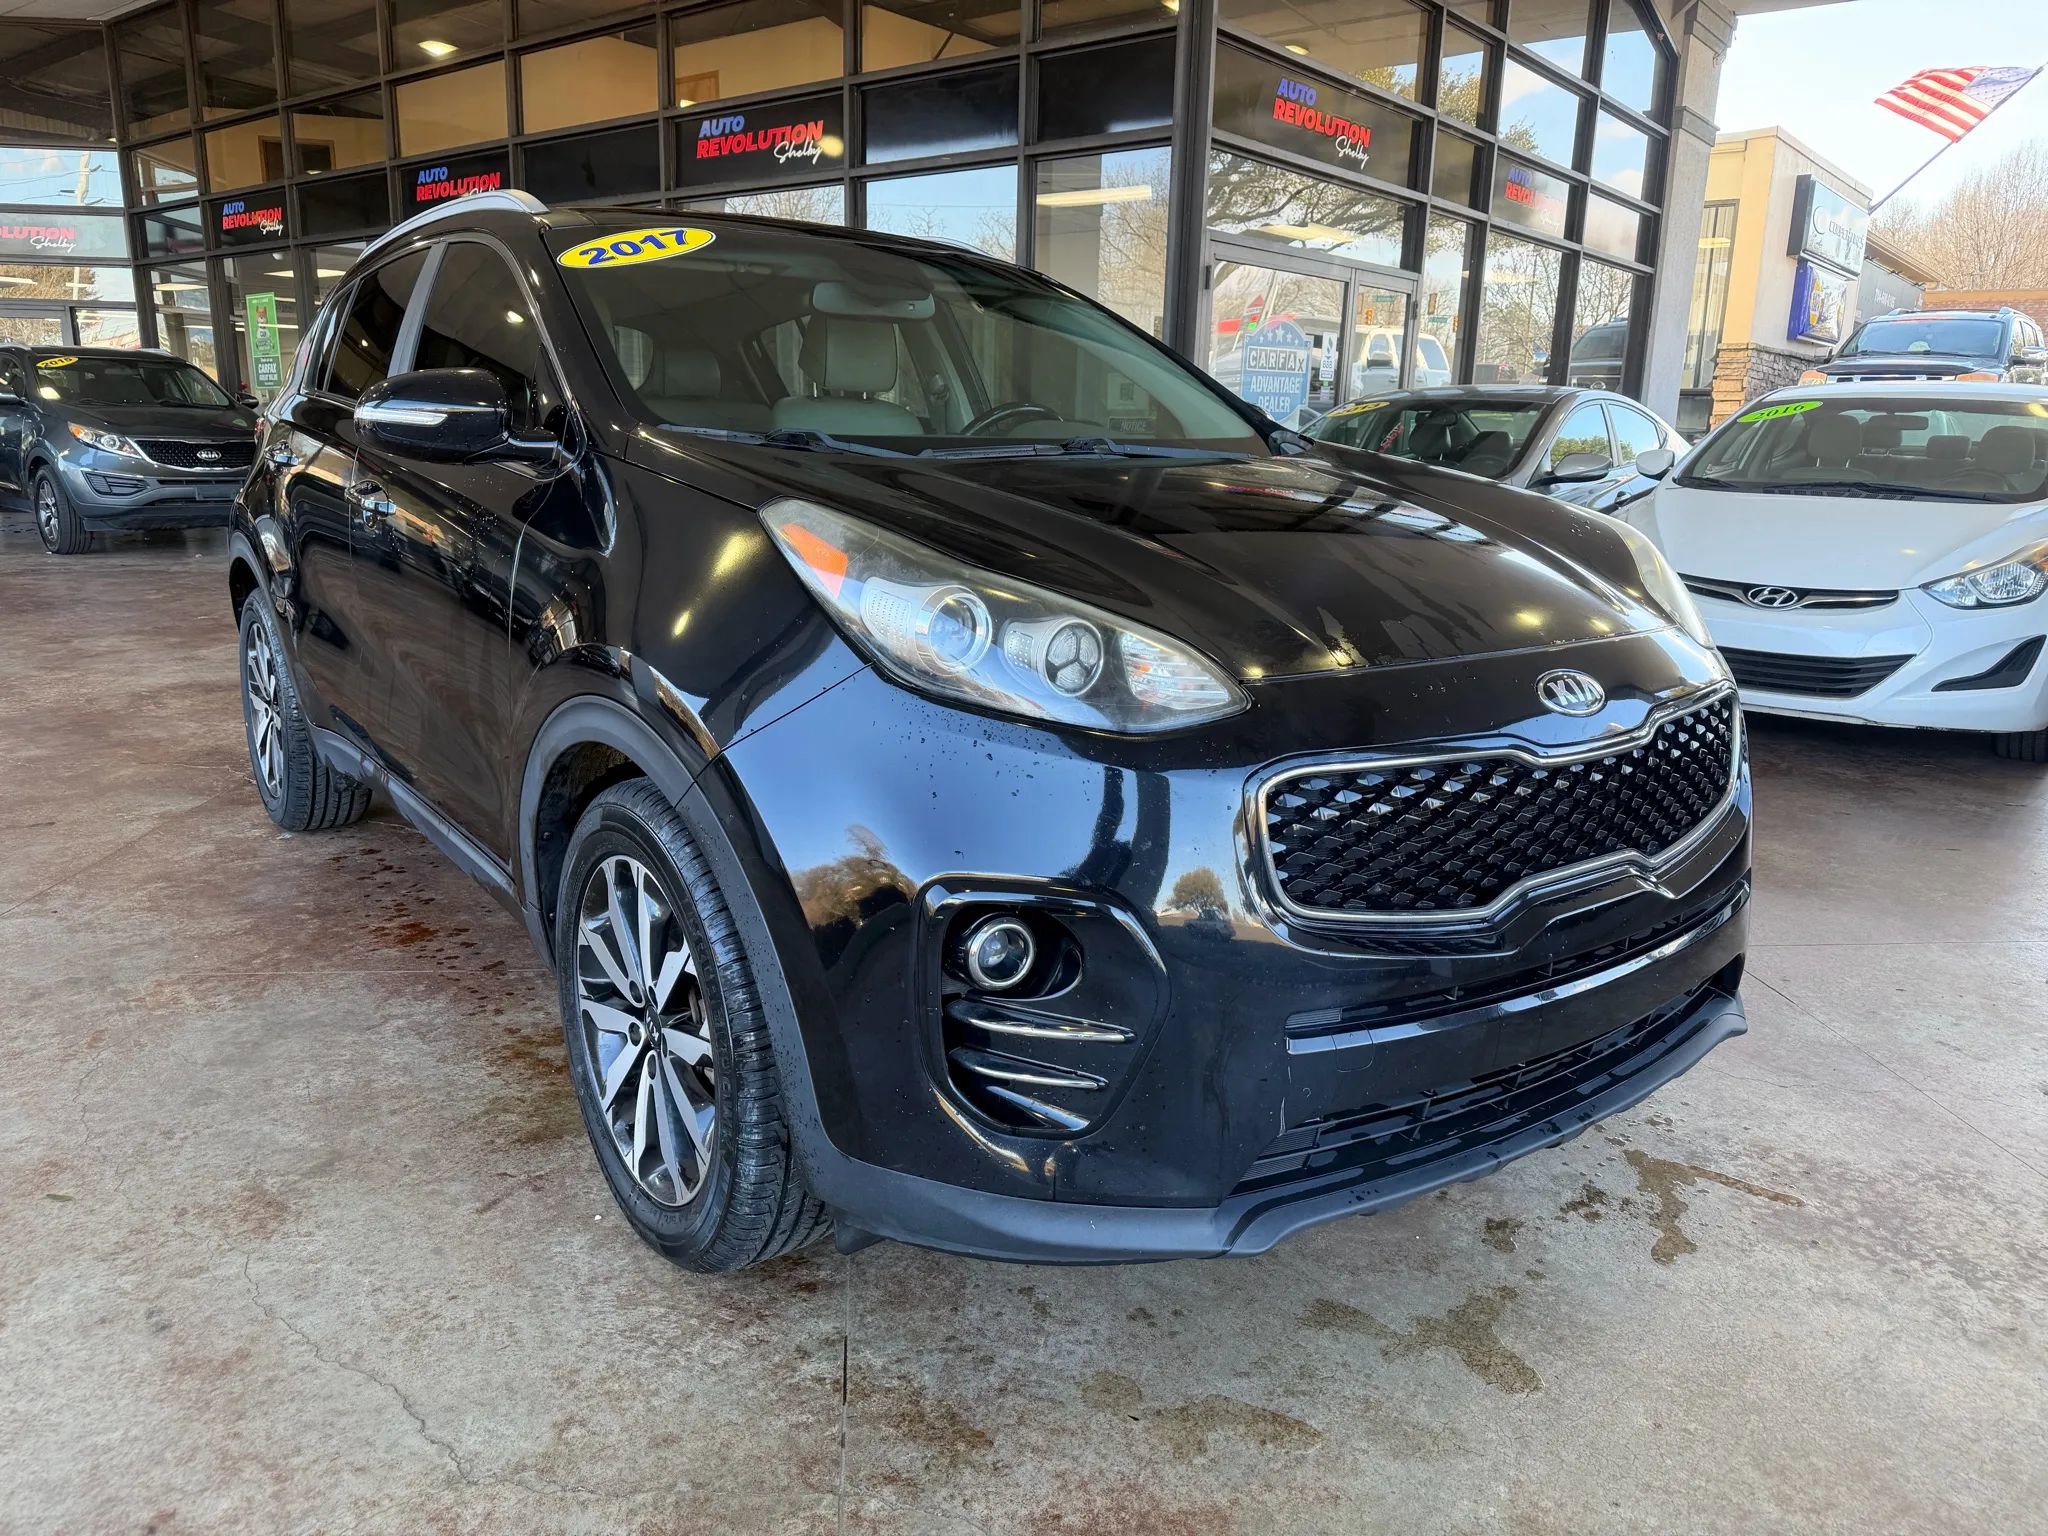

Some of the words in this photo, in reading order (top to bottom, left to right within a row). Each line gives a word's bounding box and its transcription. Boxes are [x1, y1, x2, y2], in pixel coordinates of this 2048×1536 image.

[1277, 78, 1317, 106] AUTO
[698, 115, 745, 137] AUTO
[1273, 97, 1371, 147] REVOLUTION
[696, 120, 824, 159] REVOLUTION
[773, 136, 823, 164] Shelby
[1335, 135, 1369, 170] Shelby
[416, 171, 501, 201] REVOLUTION
[417, 166, 448, 184] AUTO
[1508, 167, 1532, 187] AUTO
[222, 207, 282, 230] REVOLUTION
[223, 201, 245, 215] AUTO
[0, 225, 75, 240] LUTION
[30, 235, 77, 253] Shelby
[579, 229, 688, 266] 2017
[1249, 349, 1305, 373] CARFAX
[1249, 375, 1302, 394] ADVANTAGE
[1257, 395, 1291, 413] DEALER
[1752, 404, 1804, 420] 2016
[201, 451, 219, 459] KIA
[1546, 677, 1602, 706] KIA
